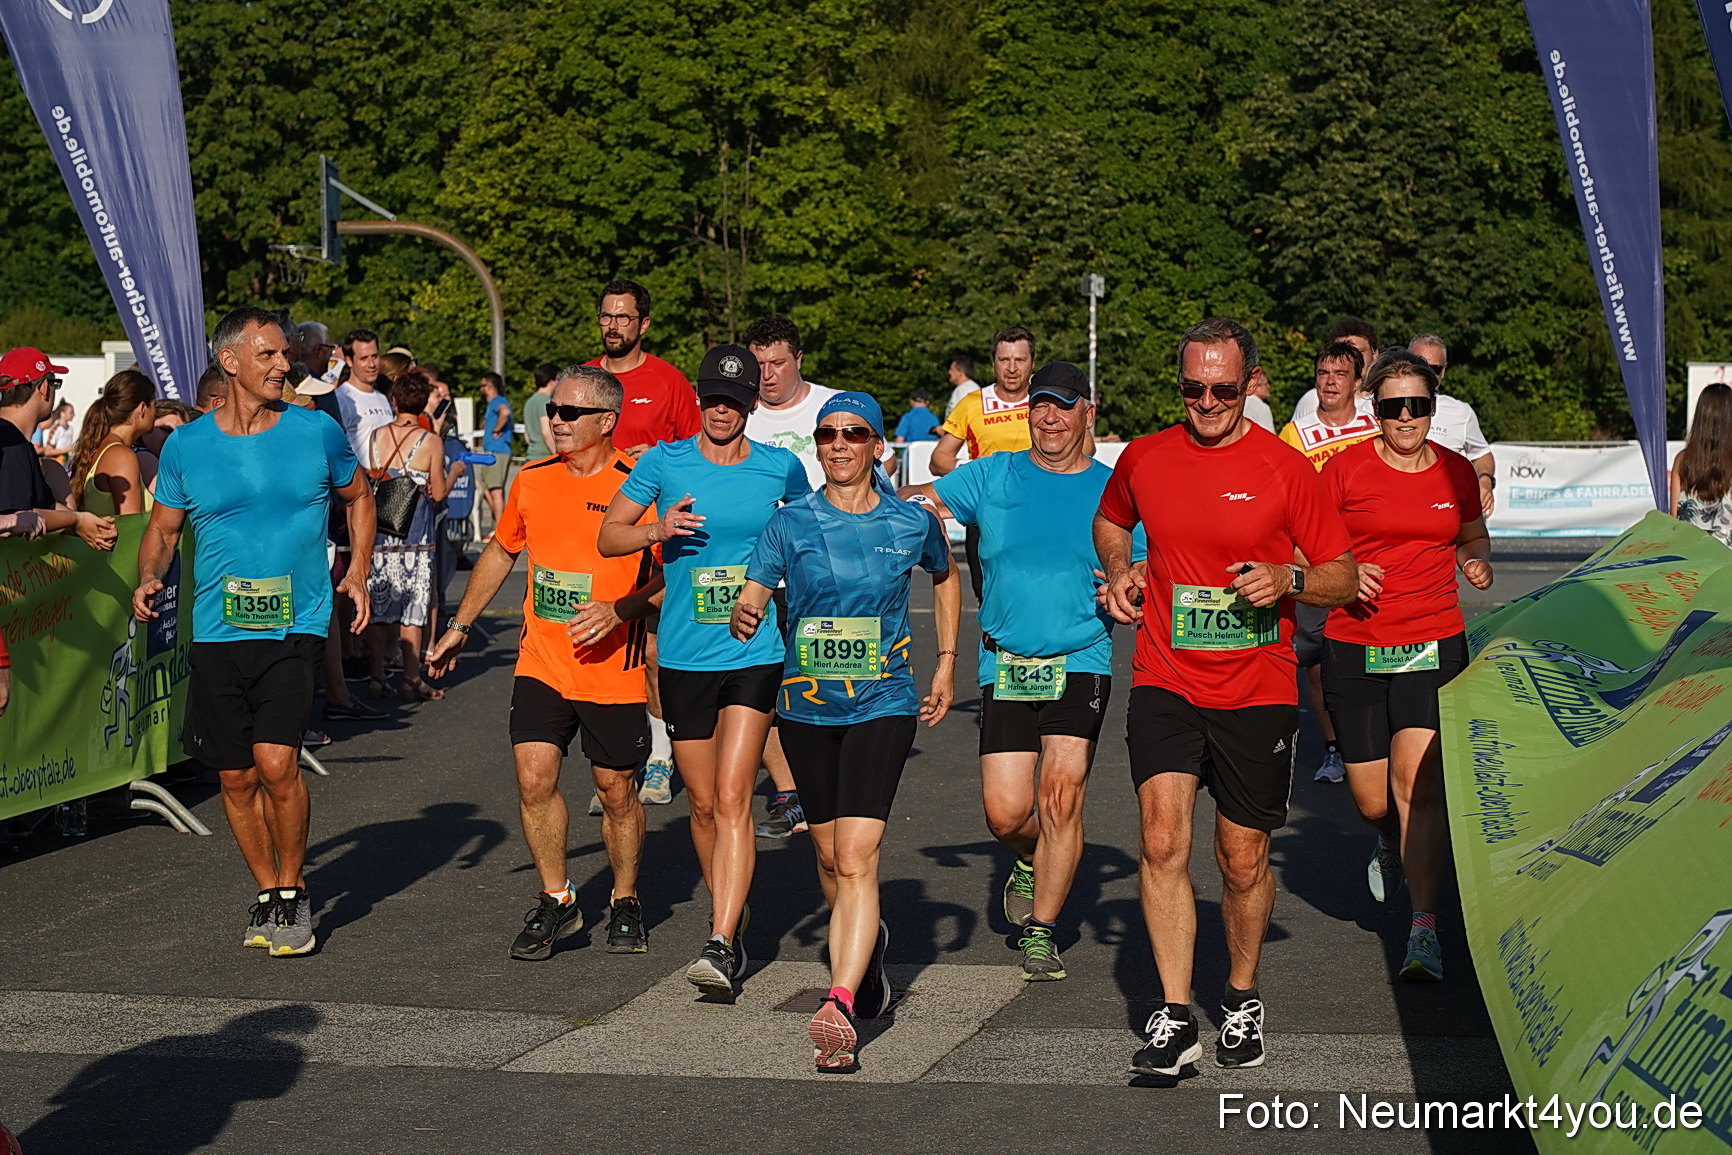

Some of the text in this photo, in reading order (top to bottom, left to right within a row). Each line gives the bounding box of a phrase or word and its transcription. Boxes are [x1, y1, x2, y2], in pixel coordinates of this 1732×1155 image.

[827, 397, 866, 409] PLAST
[983, 414, 1012, 425] MAX
[1510, 465, 1546, 479] NOW
[1563, 488, 1574, 498] &
[885, 548, 912, 556] PLAST
[233, 594, 281, 613] 1350
[540, 585, 580, 608] 1385
[697, 593, 705, 612] RUN
[706, 585, 743, 605] 134
[235, 611, 251, 619] Kolb
[282, 596, 290, 620] 2022
[1177, 613, 1185, 636] RUN
[1187, 608, 1245, 630] 1763
[1246, 610, 1254, 640] 2022
[1187, 630, 1244, 639] Pusch Helmut
[800, 645, 808, 666] RUN
[809, 638, 867, 660] 1899
[868, 642, 877, 671] 2022
[833, 661, 863, 669] Andrea
[1382, 656, 1404, 664] Stöckl
[998, 670, 1006, 690] RUN
[1007, 665, 1054, 683] 1343
[1055, 667, 1063, 692] 2022
[1029, 684, 1053, 692] Jürgen
